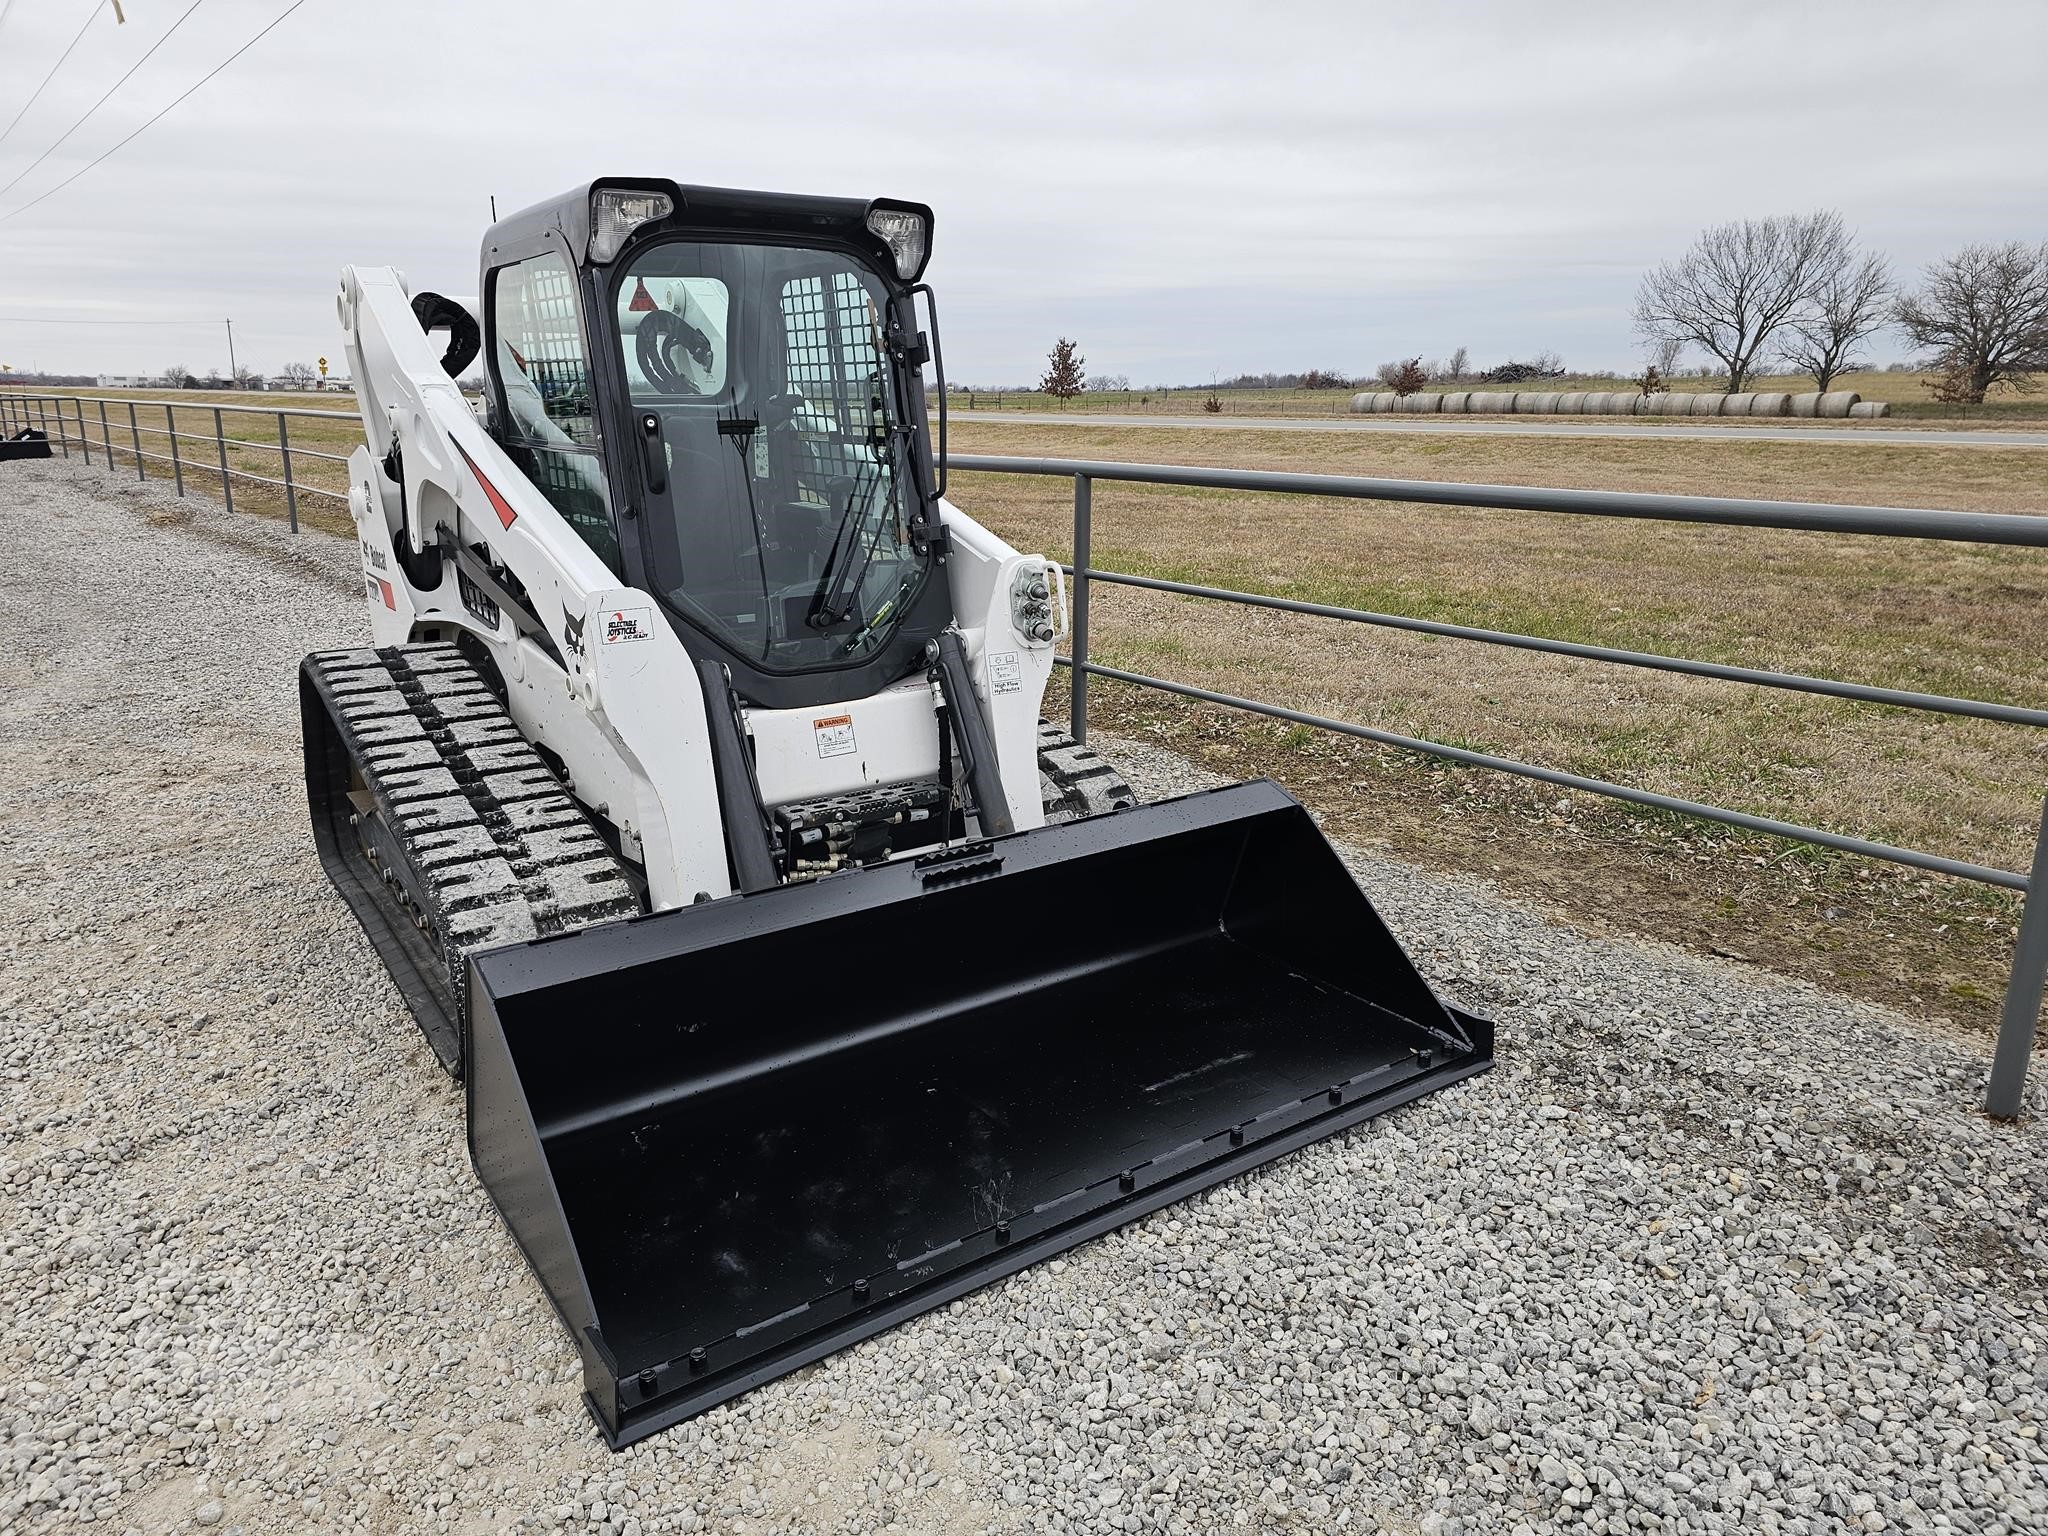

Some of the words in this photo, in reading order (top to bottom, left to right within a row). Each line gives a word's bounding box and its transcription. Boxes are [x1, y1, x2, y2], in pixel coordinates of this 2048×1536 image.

[369, 545, 388, 572] Bobcat
[608, 620, 637, 628] SELECTABLE
[607, 626, 637, 637] JOYSTICKS
[823, 717, 848, 726] WARNING
